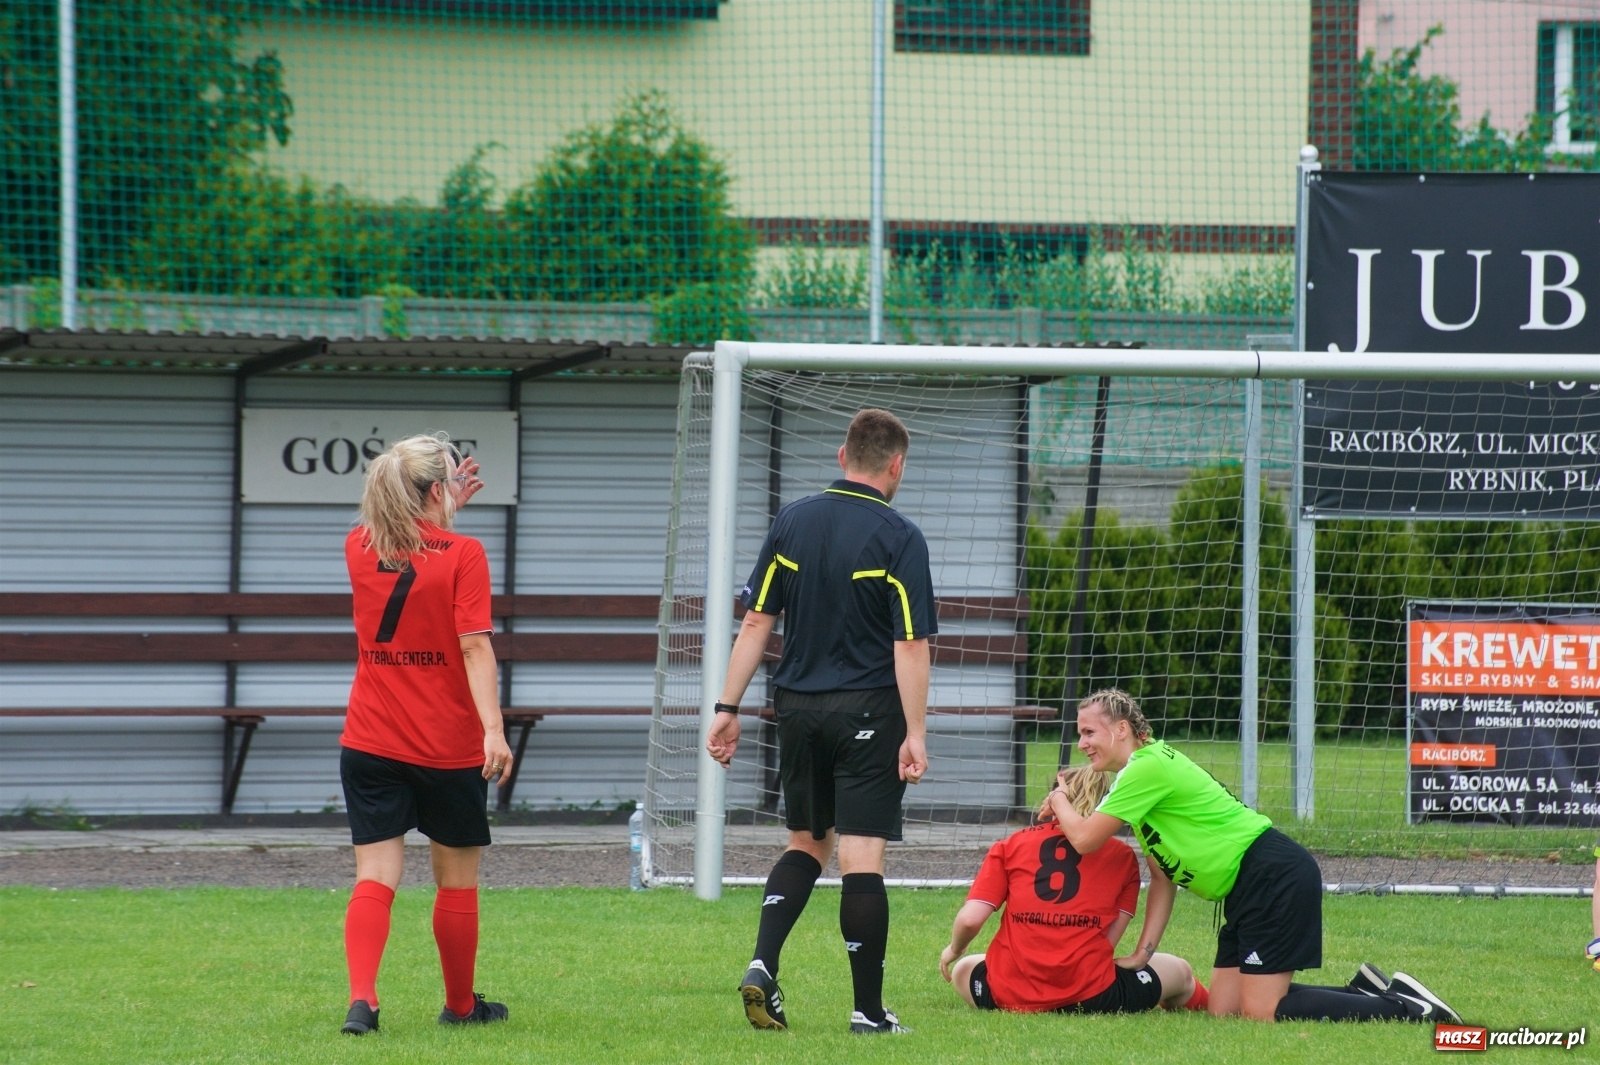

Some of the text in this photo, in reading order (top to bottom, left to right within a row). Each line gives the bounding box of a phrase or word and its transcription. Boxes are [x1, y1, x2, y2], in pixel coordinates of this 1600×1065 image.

[1327, 248, 1587, 353] JUB
[281, 427, 478, 475] GOŚE
[1329, 427, 1467, 457] RACIBÓRZ,
[1477, 433, 1517, 454] UL.
[1449, 470, 1600, 495] RYBNIK, PL
[375, 558, 418, 643] 7
[363, 650, 448, 666] TBALLCENTER.PL
[1421, 631, 1600, 671] KREWET
[1421, 672, 1474, 687] SKLEP
[1480, 673, 1536, 688] RYBNY
[1547, 675, 1559, 689] &
[1421, 696, 1600, 717] RYBY ŚWIEŻE, MROŻONE,
[1475, 716, 1523, 728] MORSKIE
[1526, 717, 1531, 727] I
[1422, 746, 1487, 762] RACIBÓRZ
[1422, 777, 1445, 790] UL.
[1450, 775, 1530, 793] ZBOROWA
[1536, 777, 1558, 794] 5A
[1570, 780, 1592, 794] tel.
[1422, 798, 1445, 811] UL.
[1450, 796, 1511, 812] OCICKA
[1516, 798, 1525, 814] 5
[1538, 801, 1561, 815] tel.
[1564, 802, 1580, 815] 32
[1034, 835, 1083, 905] 8
